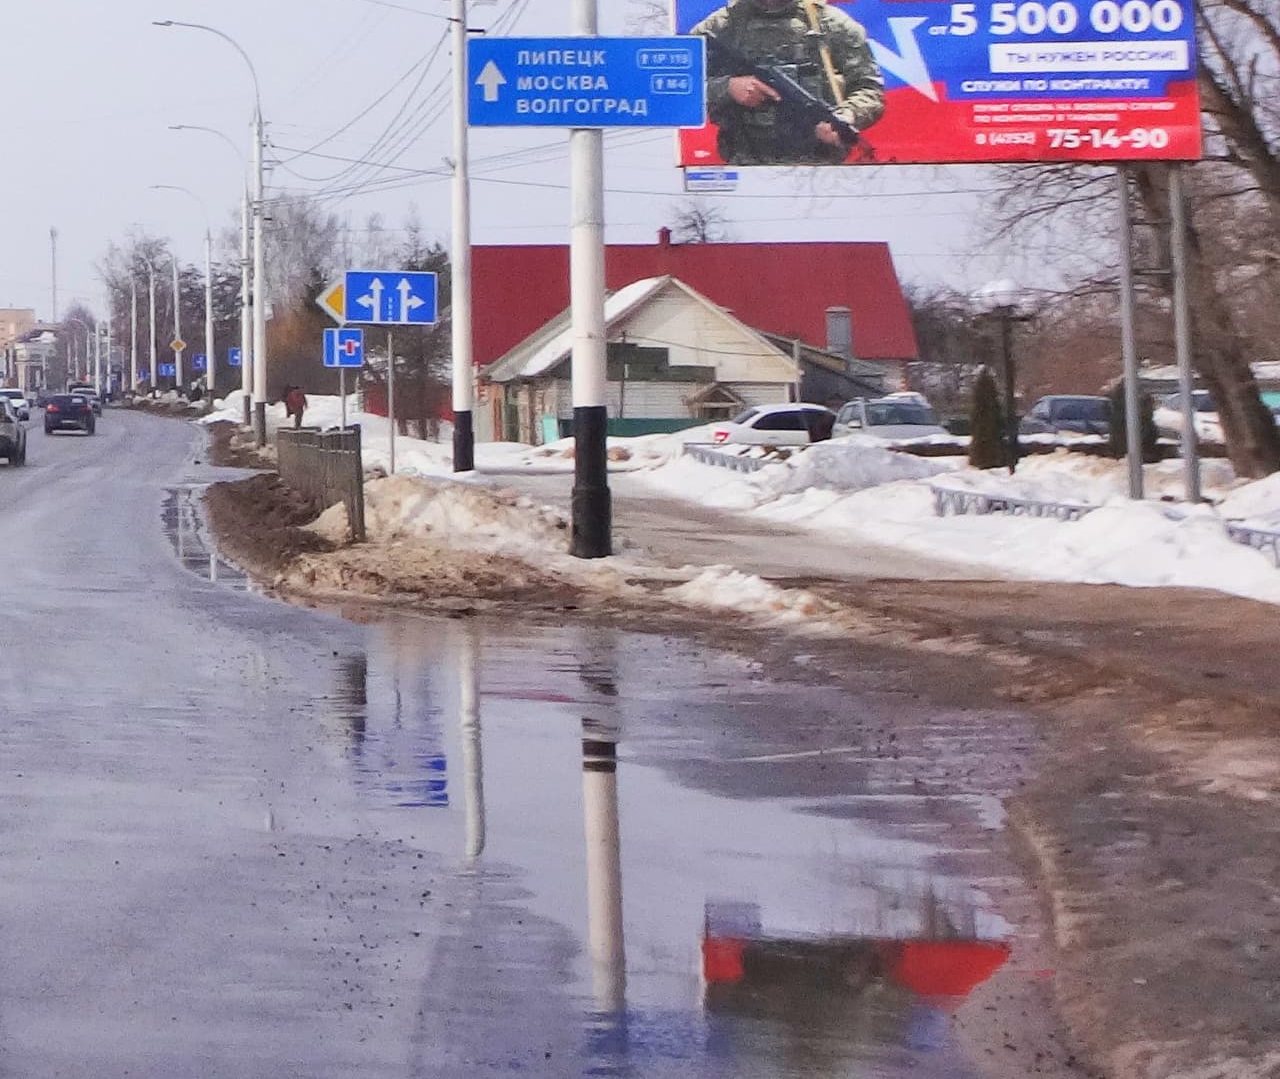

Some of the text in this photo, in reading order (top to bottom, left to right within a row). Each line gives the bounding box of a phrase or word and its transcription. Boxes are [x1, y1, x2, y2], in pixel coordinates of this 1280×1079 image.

[949, 3, 977, 36] 5
[989, 1, 1078, 35] 500
[1090, 0, 1183, 34] 000
[517, 50, 606, 67] ЛИПЕЦК
[1007, 52, 1030, 63] ТЫ
[1037, 51, 1096, 63] НУЖЕН
[517, 75, 609, 91] МОСКВА
[516, 98, 648, 117] ВОЛГОГРАД
[1045, 127, 1169, 149] 75-14-90
